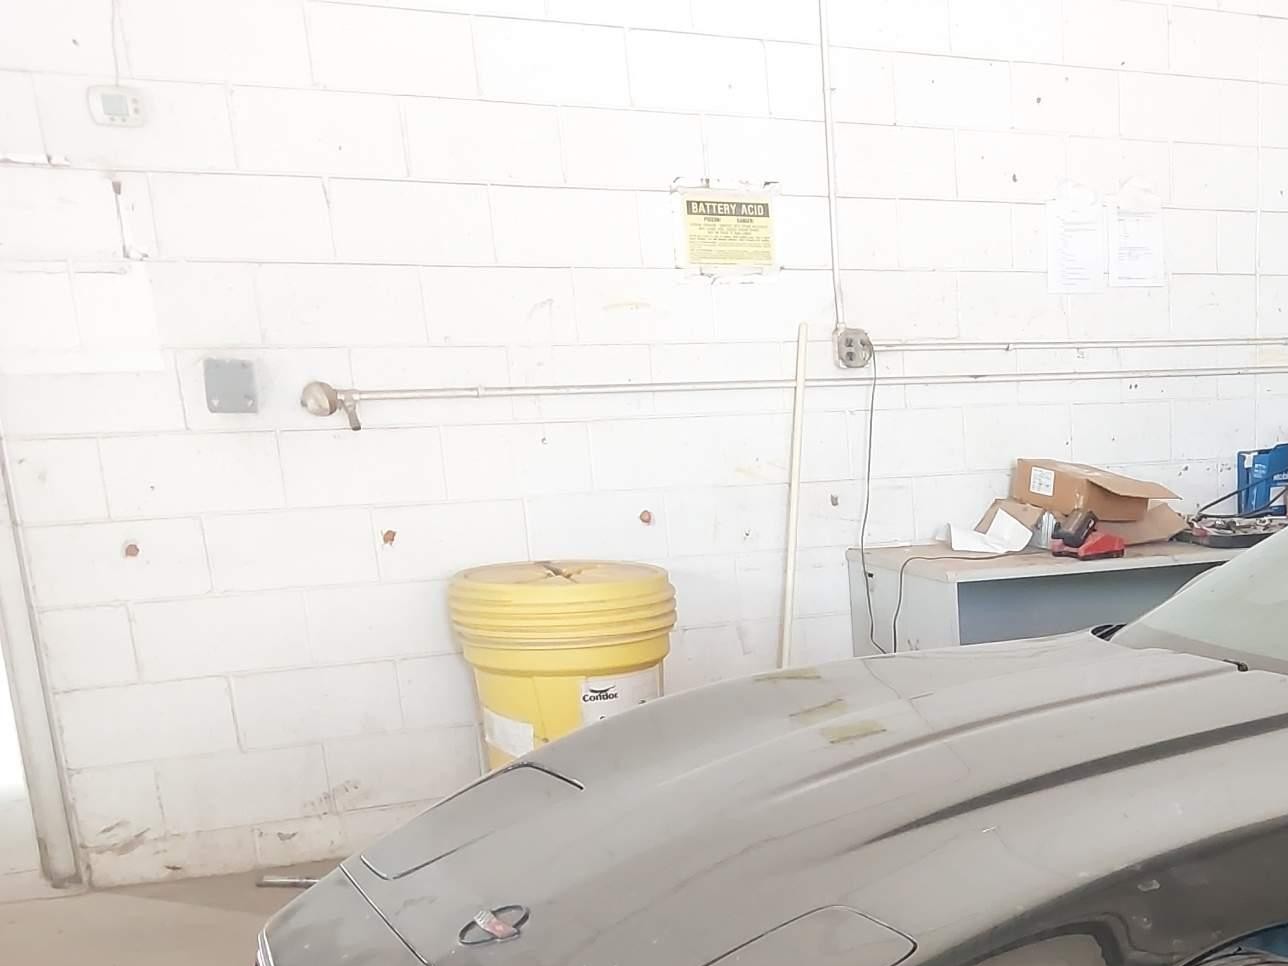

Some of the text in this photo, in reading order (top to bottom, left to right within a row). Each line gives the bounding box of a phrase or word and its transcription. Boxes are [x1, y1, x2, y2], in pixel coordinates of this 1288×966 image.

[691, 201, 764, 216] BATTERY ACID
[582, 690, 619, 703] Condor
